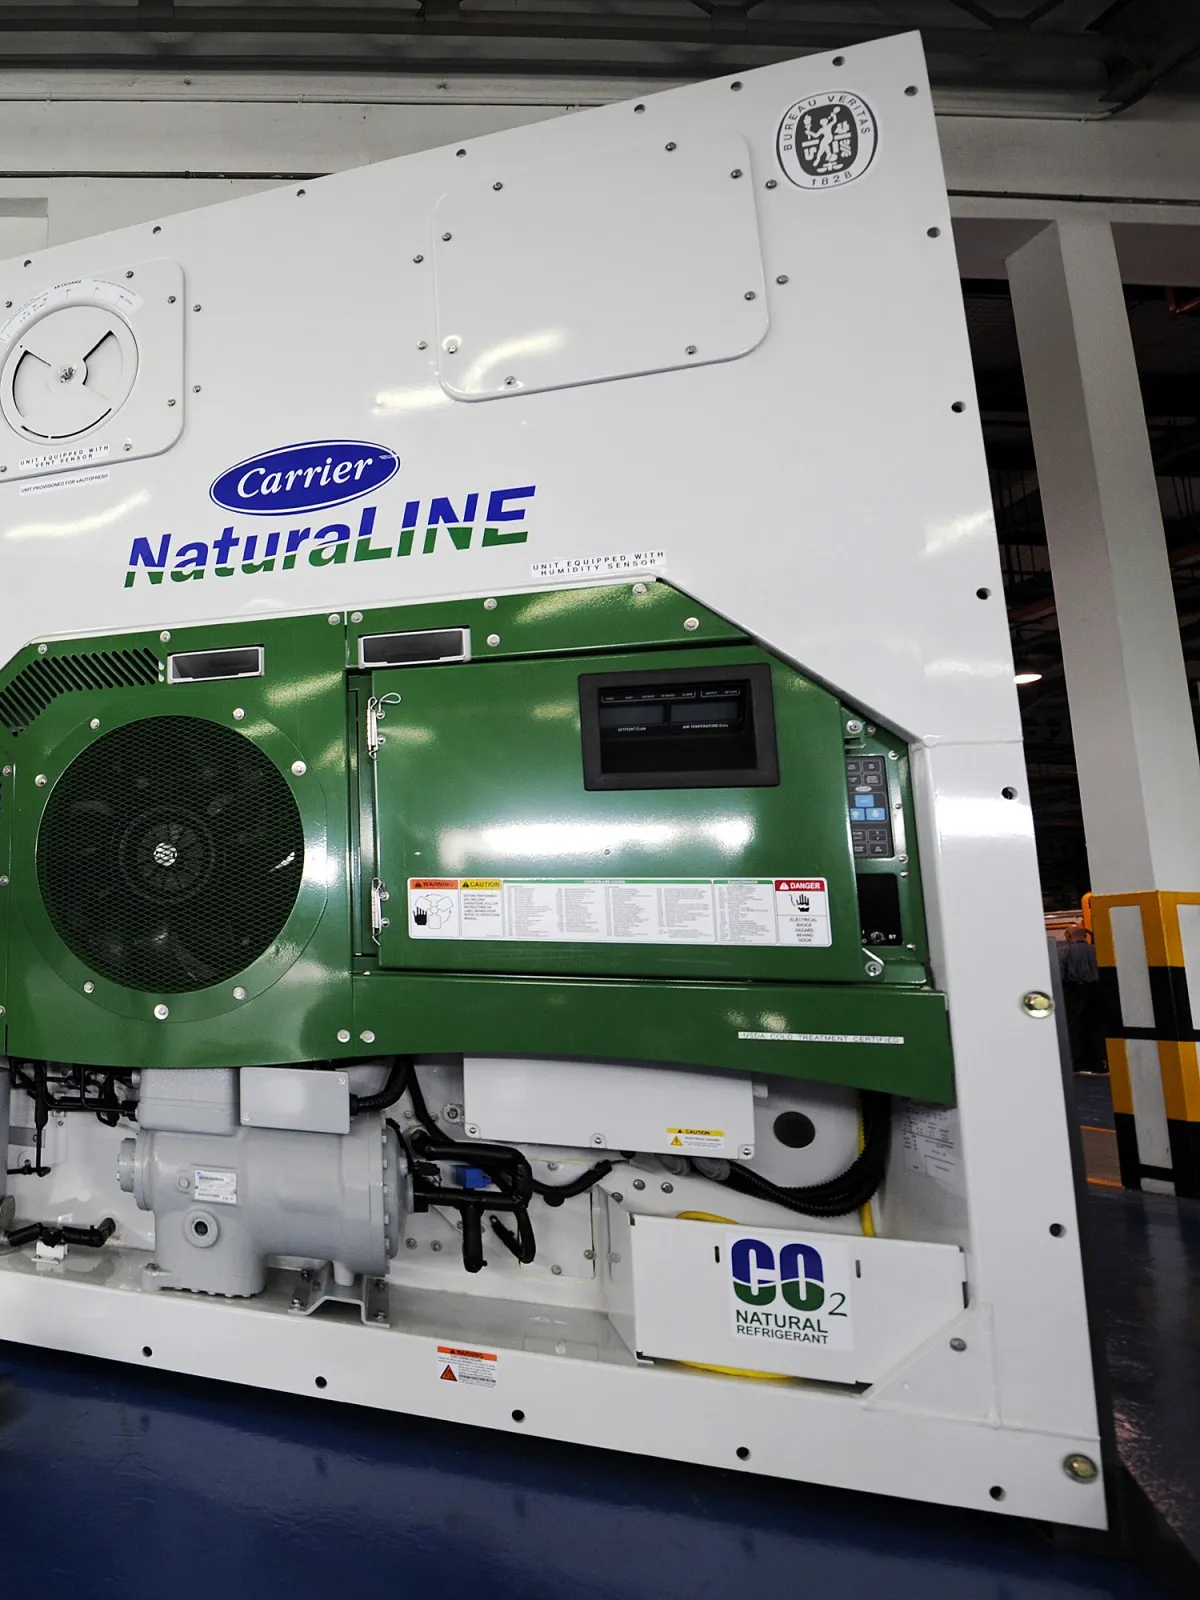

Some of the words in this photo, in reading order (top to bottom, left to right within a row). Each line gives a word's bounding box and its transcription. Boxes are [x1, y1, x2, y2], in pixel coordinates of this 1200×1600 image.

[784, 99, 817, 151] BUREAU
[827, 95, 870, 134] VERITAS
[812, 171, 852, 186] 1828
[20, 457, 39, 465] UNIT
[43, 450, 84, 461] EQUIPPED
[88, 445, 109, 453] WITH
[35, 460, 55, 468] VENT
[60, 453, 93, 463] SENSOR
[236, 457, 373, 499] Carrier
[123, 485, 536, 588] NaturaLINE
[533, 562, 559, 570] UNIT
[567, 555, 626, 566] EQUIPPED
[634, 551, 664, 559] WITH
[540, 565, 600, 576] HUMIDITY
[607, 558, 656, 570] SENSOR
[798, 1034, 849, 1042] TREATMENT
[736, 1309, 829, 1333] NATURAL
[736, 1324, 829, 1345] REFRIGERANT
